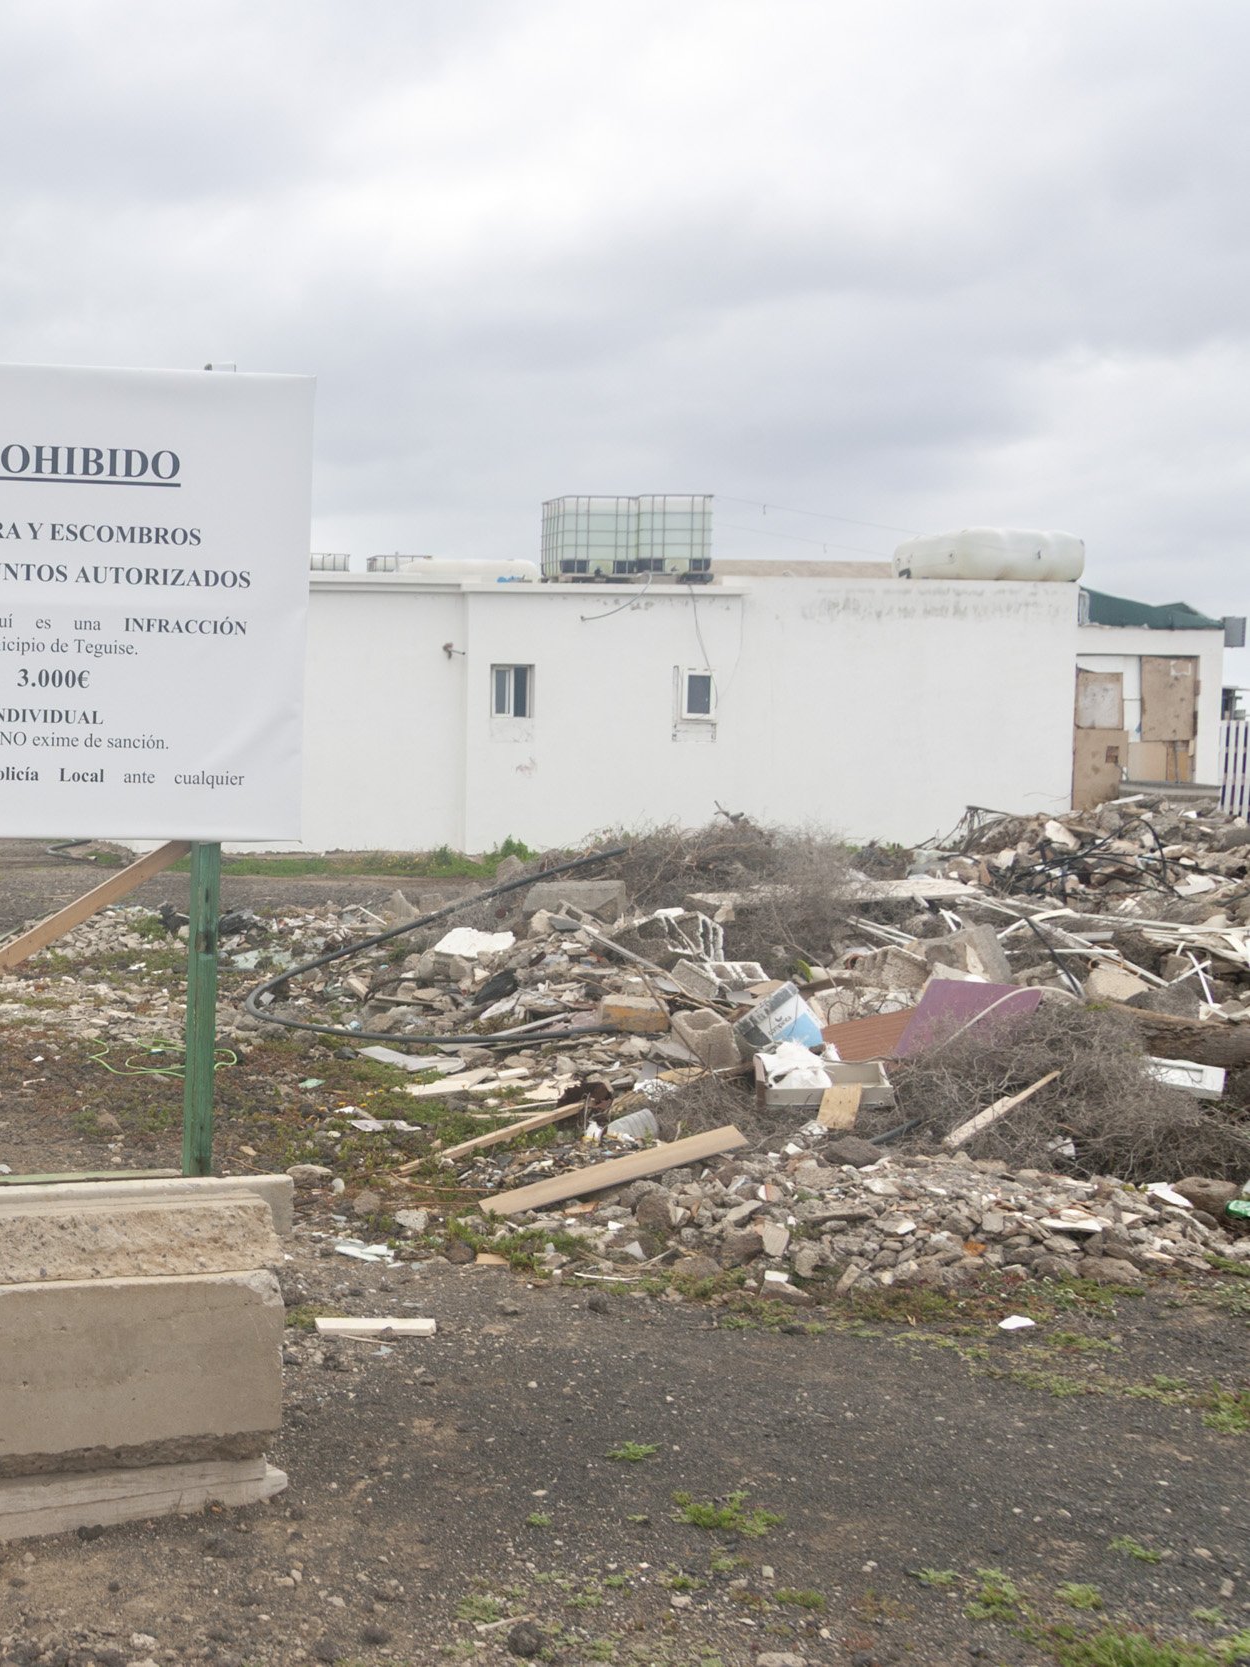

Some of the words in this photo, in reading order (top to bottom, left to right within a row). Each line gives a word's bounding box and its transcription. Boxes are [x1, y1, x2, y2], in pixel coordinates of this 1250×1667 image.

[27, 522, 43, 540] Y
[50, 523, 201, 546] ESCOMBROS
[75, 566, 250, 588] AUTORIZADOS
[36, 619, 51, 629] es
[74, 620, 101, 631] una
[125, 616, 247, 635] INFRACCIÓN
[51, 638, 68, 653] de
[74, 639, 138, 658] Teguise.
[17, 668, 90, 688] 3.000€
[0, 731, 27, 746] NO
[32, 732, 79, 747] exime
[84, 733, 102, 748] de
[107, 734, 168, 749] sanción.
[59, 768, 104, 782] Local
[124, 771, 155, 784] ante
[174, 771, 244, 789] cualquier
